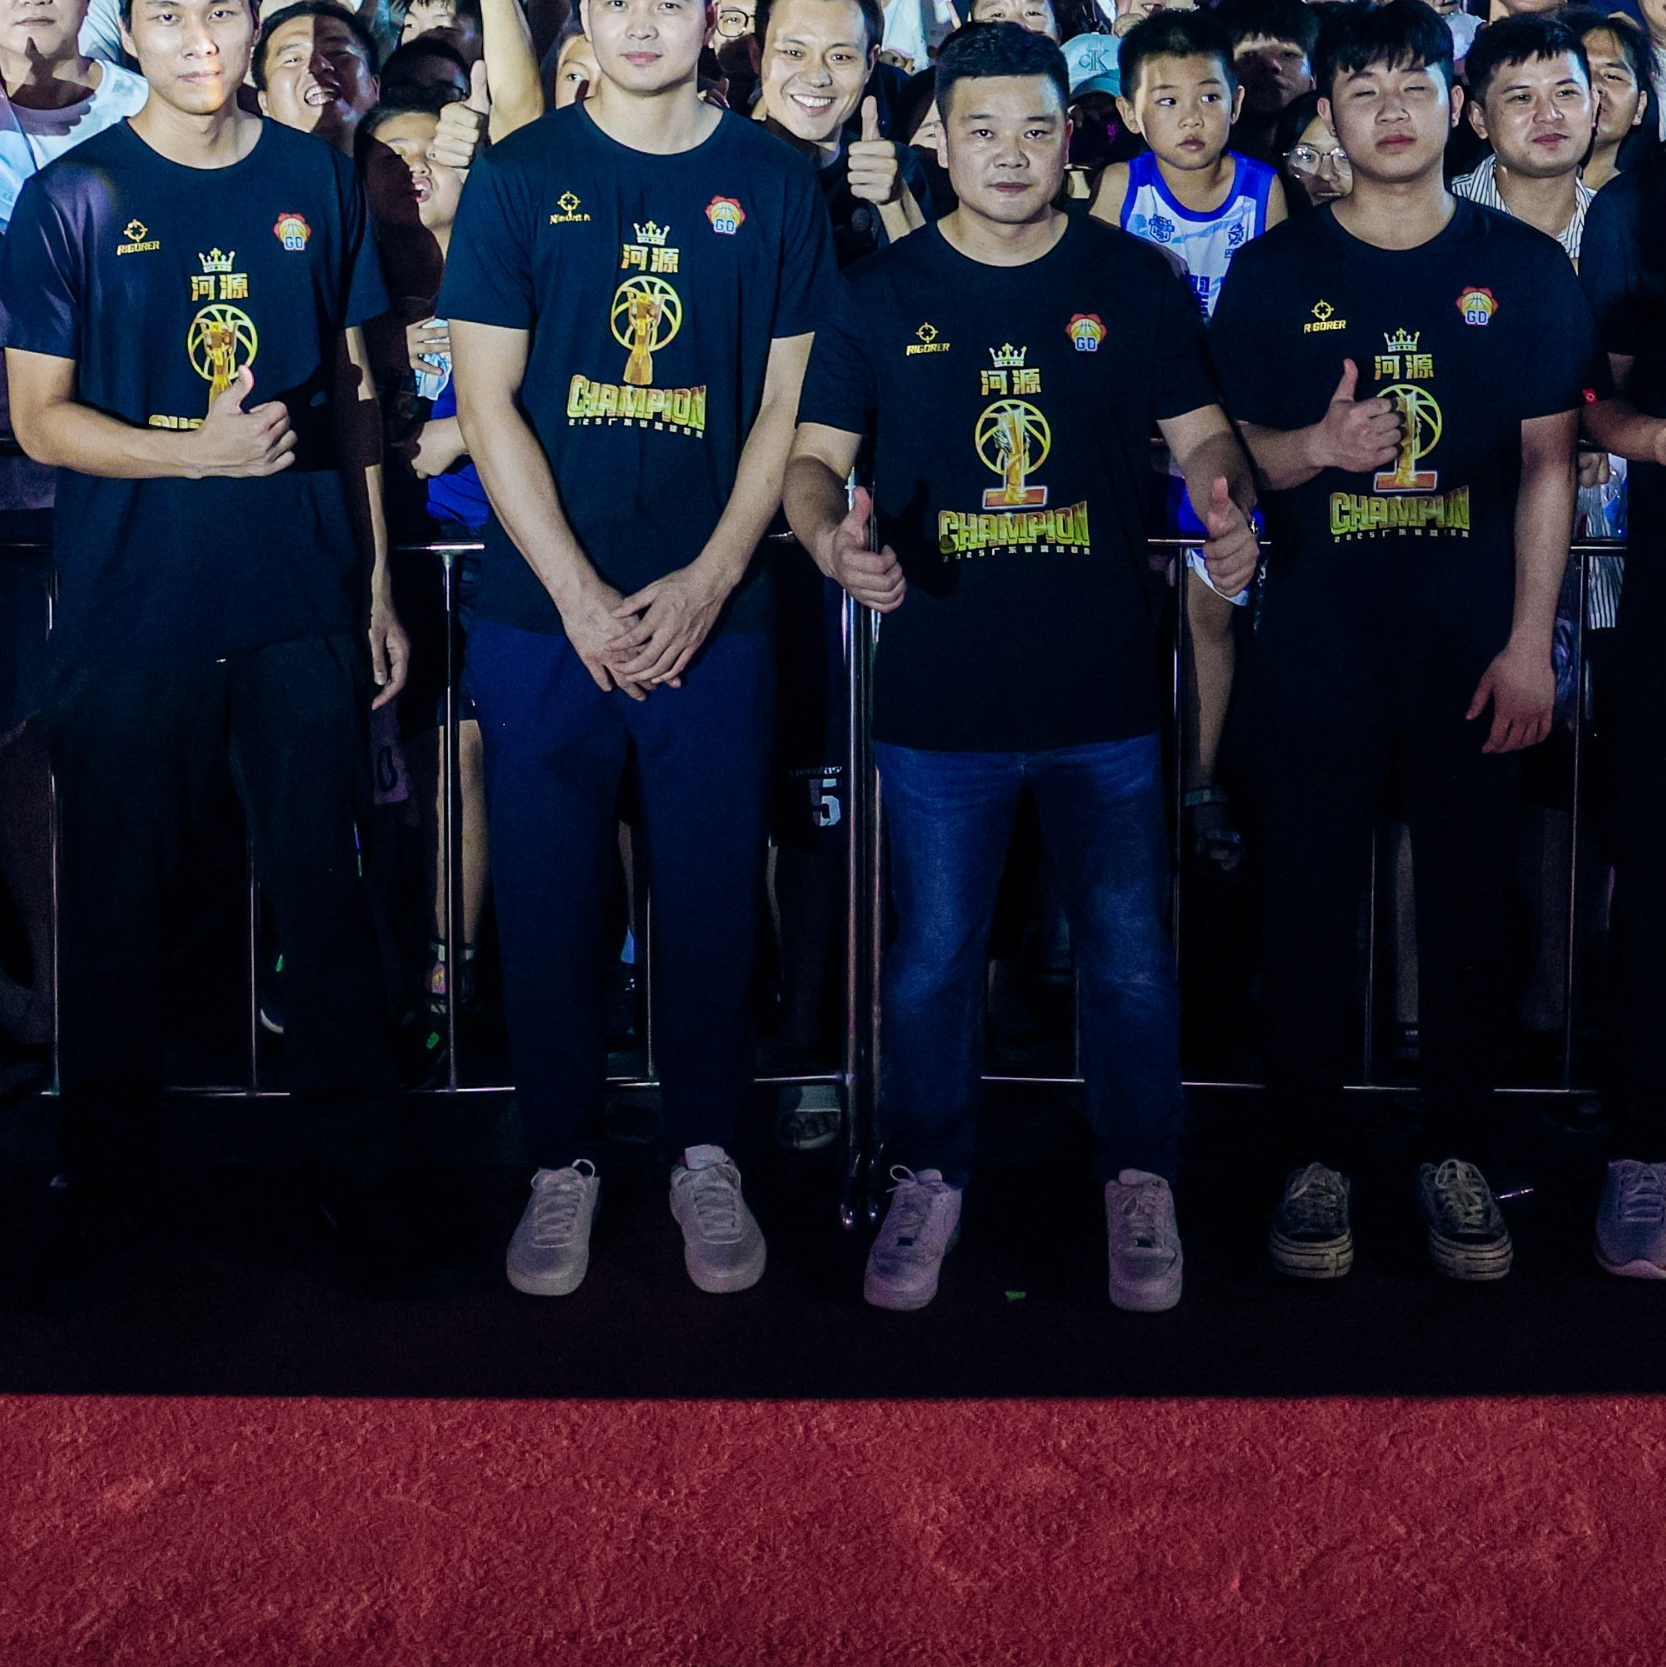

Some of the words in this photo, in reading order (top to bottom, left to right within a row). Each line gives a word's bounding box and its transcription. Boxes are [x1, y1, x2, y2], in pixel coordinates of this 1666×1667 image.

[714, 218, 736, 234] GD
[116, 240, 161, 256] RIGORER
[284, 236, 304, 251] GD
[620, 243, 680, 274] 河源
[190, 273, 249, 302] 河源
[1303, 319, 1347, 334] RGORER
[1465, 309, 1489, 325] GD
[905, 342, 951, 357] RIGORER
[1076, 337, 1098, 352] GD
[1374, 353, 1435, 380] 河源
[980, 368, 1042, 396] 河源
[566, 374, 707, 432] CHAMPION
[938, 500, 1091, 555] CHAMPION
[809, 778, 842, 827] 5
